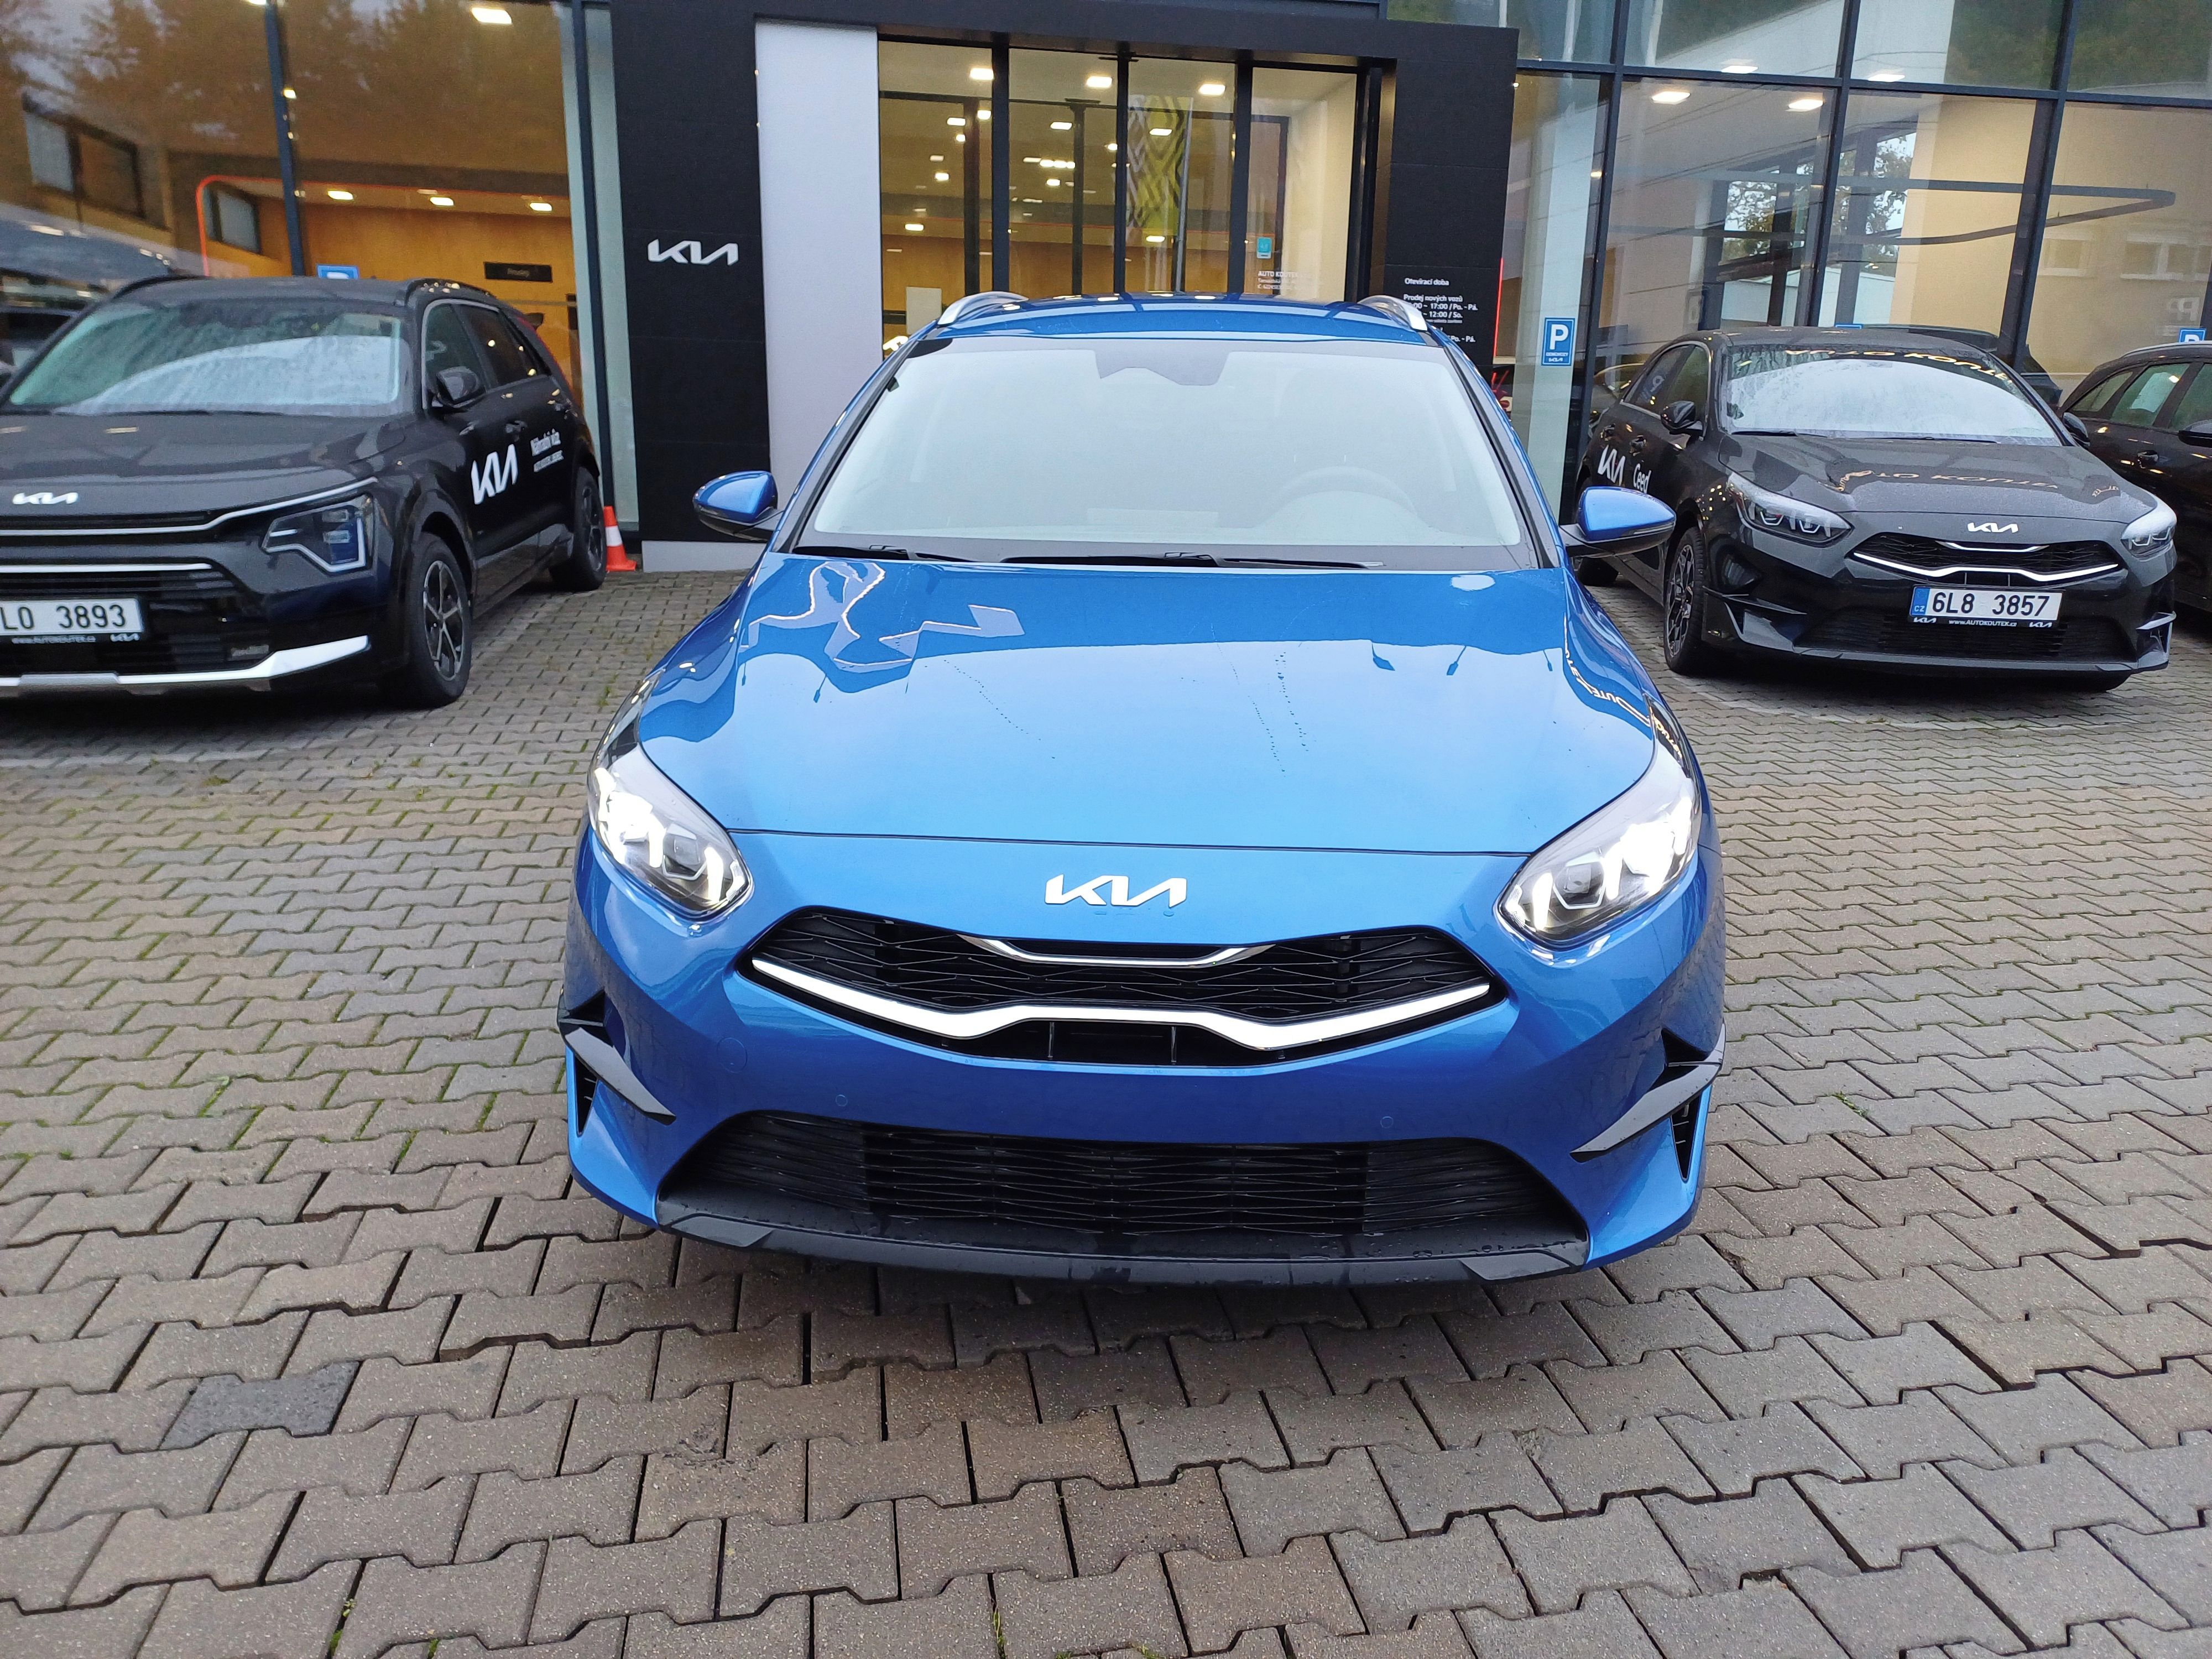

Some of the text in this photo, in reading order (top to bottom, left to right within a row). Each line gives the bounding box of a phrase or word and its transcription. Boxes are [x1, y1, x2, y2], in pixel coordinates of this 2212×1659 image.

[648, 239, 739, 266] KIA
[1550, 324, 1569, 349] P
[471, 444, 518, 505] KIA
[1598, 444, 1652, 494] KIA Ceed
[1967, 522, 2019, 534] KIA
[56, 604, 126, 628] 3893
[1932, 592, 2049, 617] 6L8 3857
[1045, 875, 1187, 907] KIA
